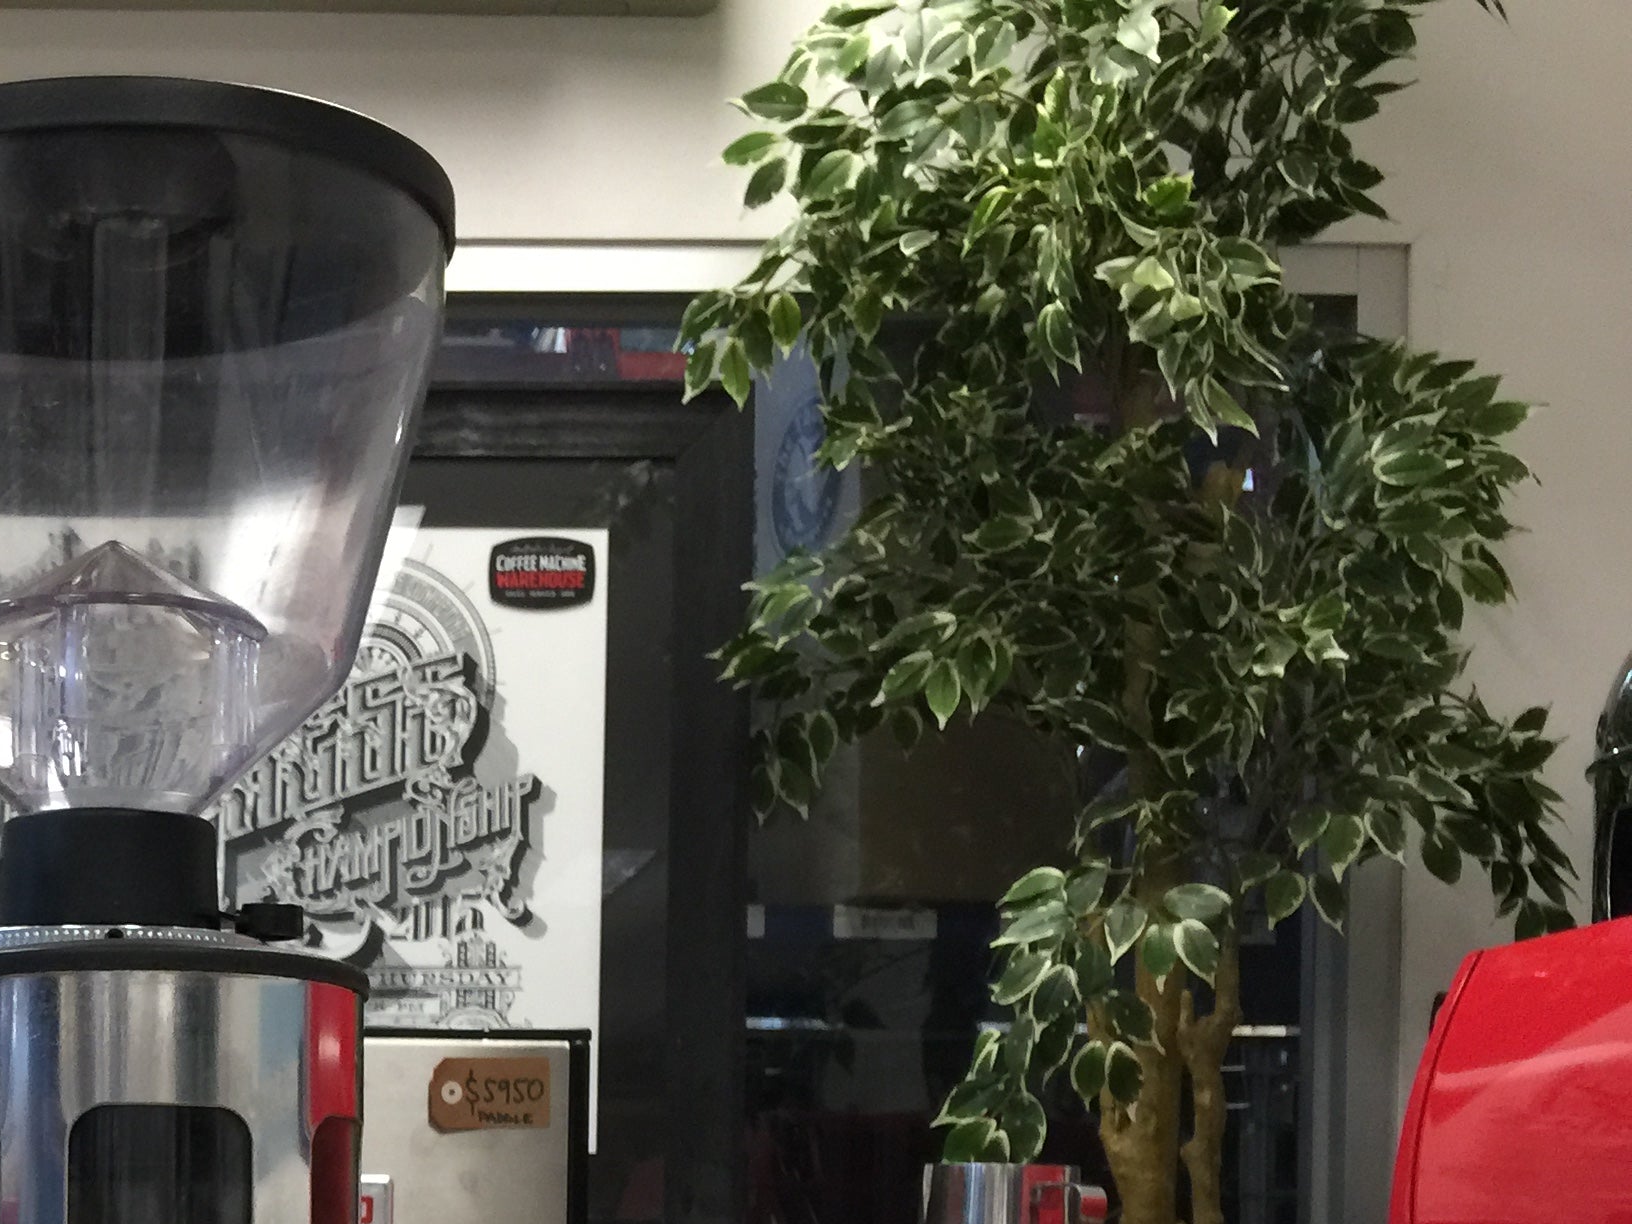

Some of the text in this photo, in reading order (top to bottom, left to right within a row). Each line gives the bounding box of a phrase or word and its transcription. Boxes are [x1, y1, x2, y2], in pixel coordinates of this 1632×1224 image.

[496, 554, 586, 571] COFFEE MACHINE
[495, 571, 585, 588] WAREHOUSE
